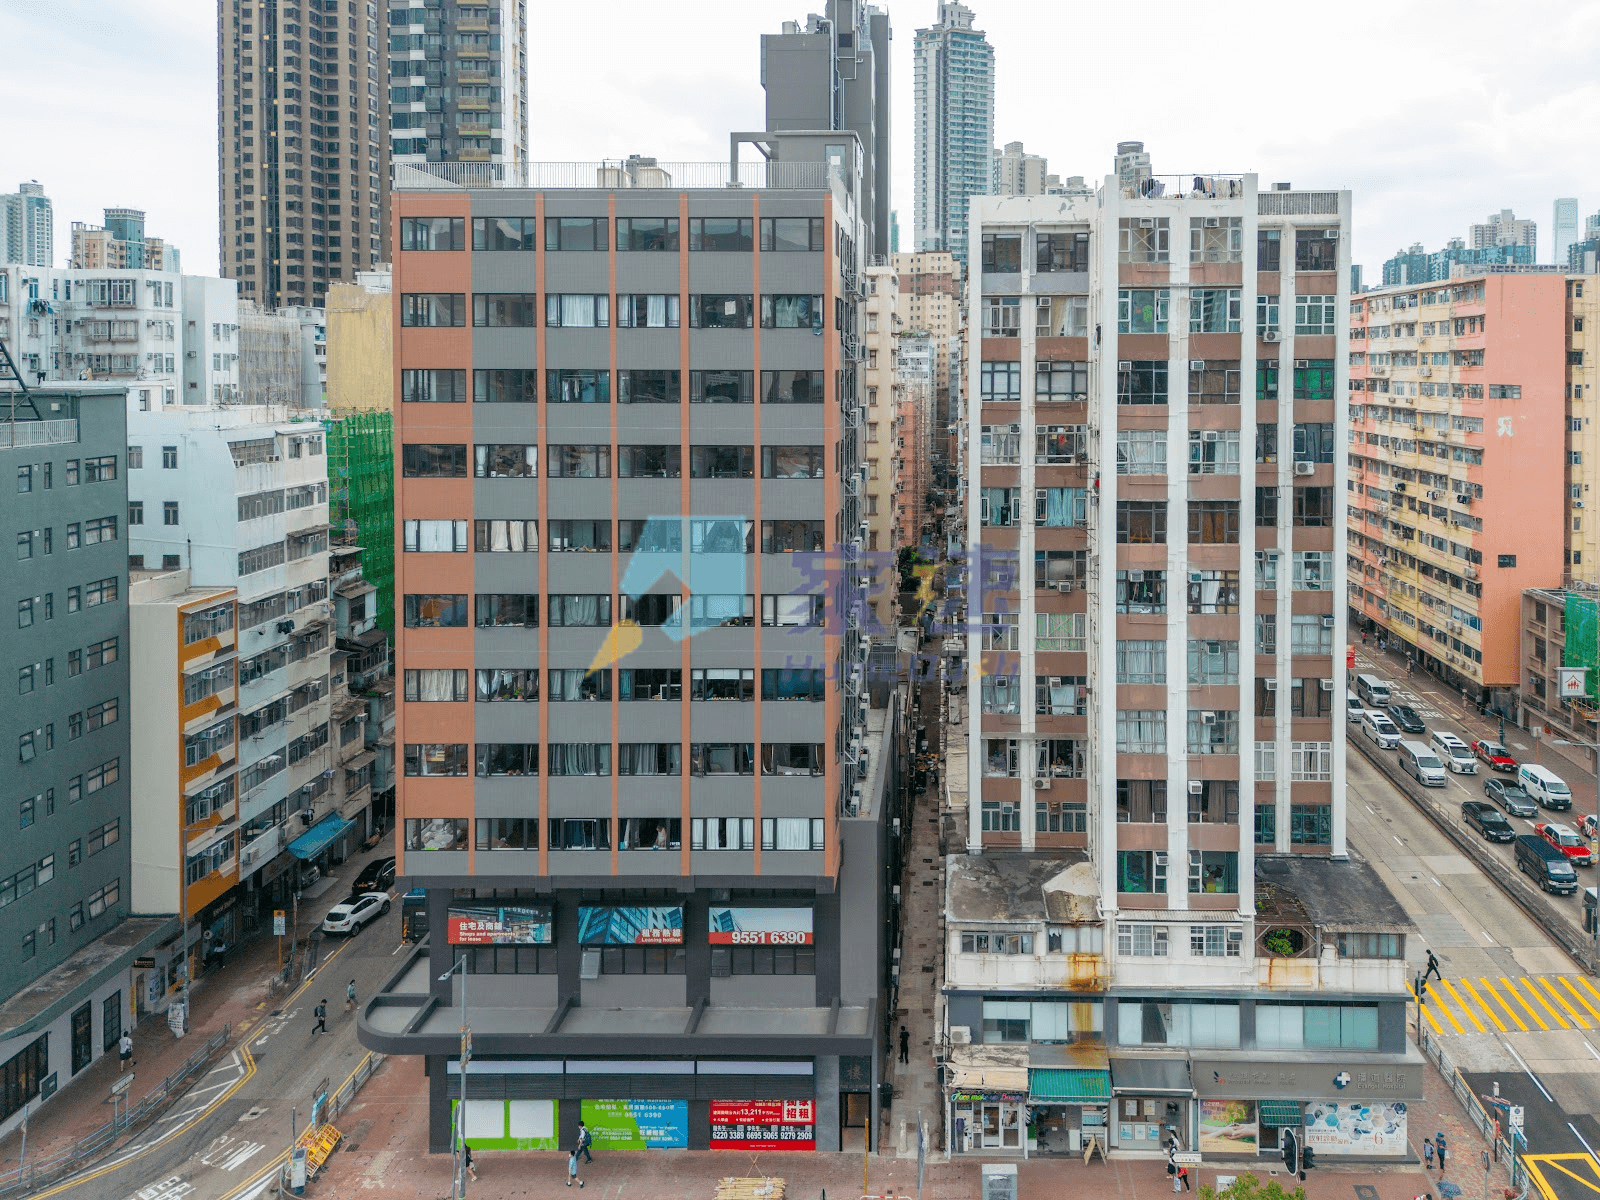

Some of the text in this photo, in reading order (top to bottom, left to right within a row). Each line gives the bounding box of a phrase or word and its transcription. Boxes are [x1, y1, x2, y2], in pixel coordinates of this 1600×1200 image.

[731, 932, 806, 944] 9551 6390
[1357, 1073, 1406, 1083] 播道醫院
[786, 1108, 810, 1119] 招租
[712, 1131, 745, 1139] 6220 3389
[746, 1131, 778, 1139] 6695 5065
[780, 1131, 813, 1139] 9279 2909
[189, 1136, 266, 1171] SLOW
